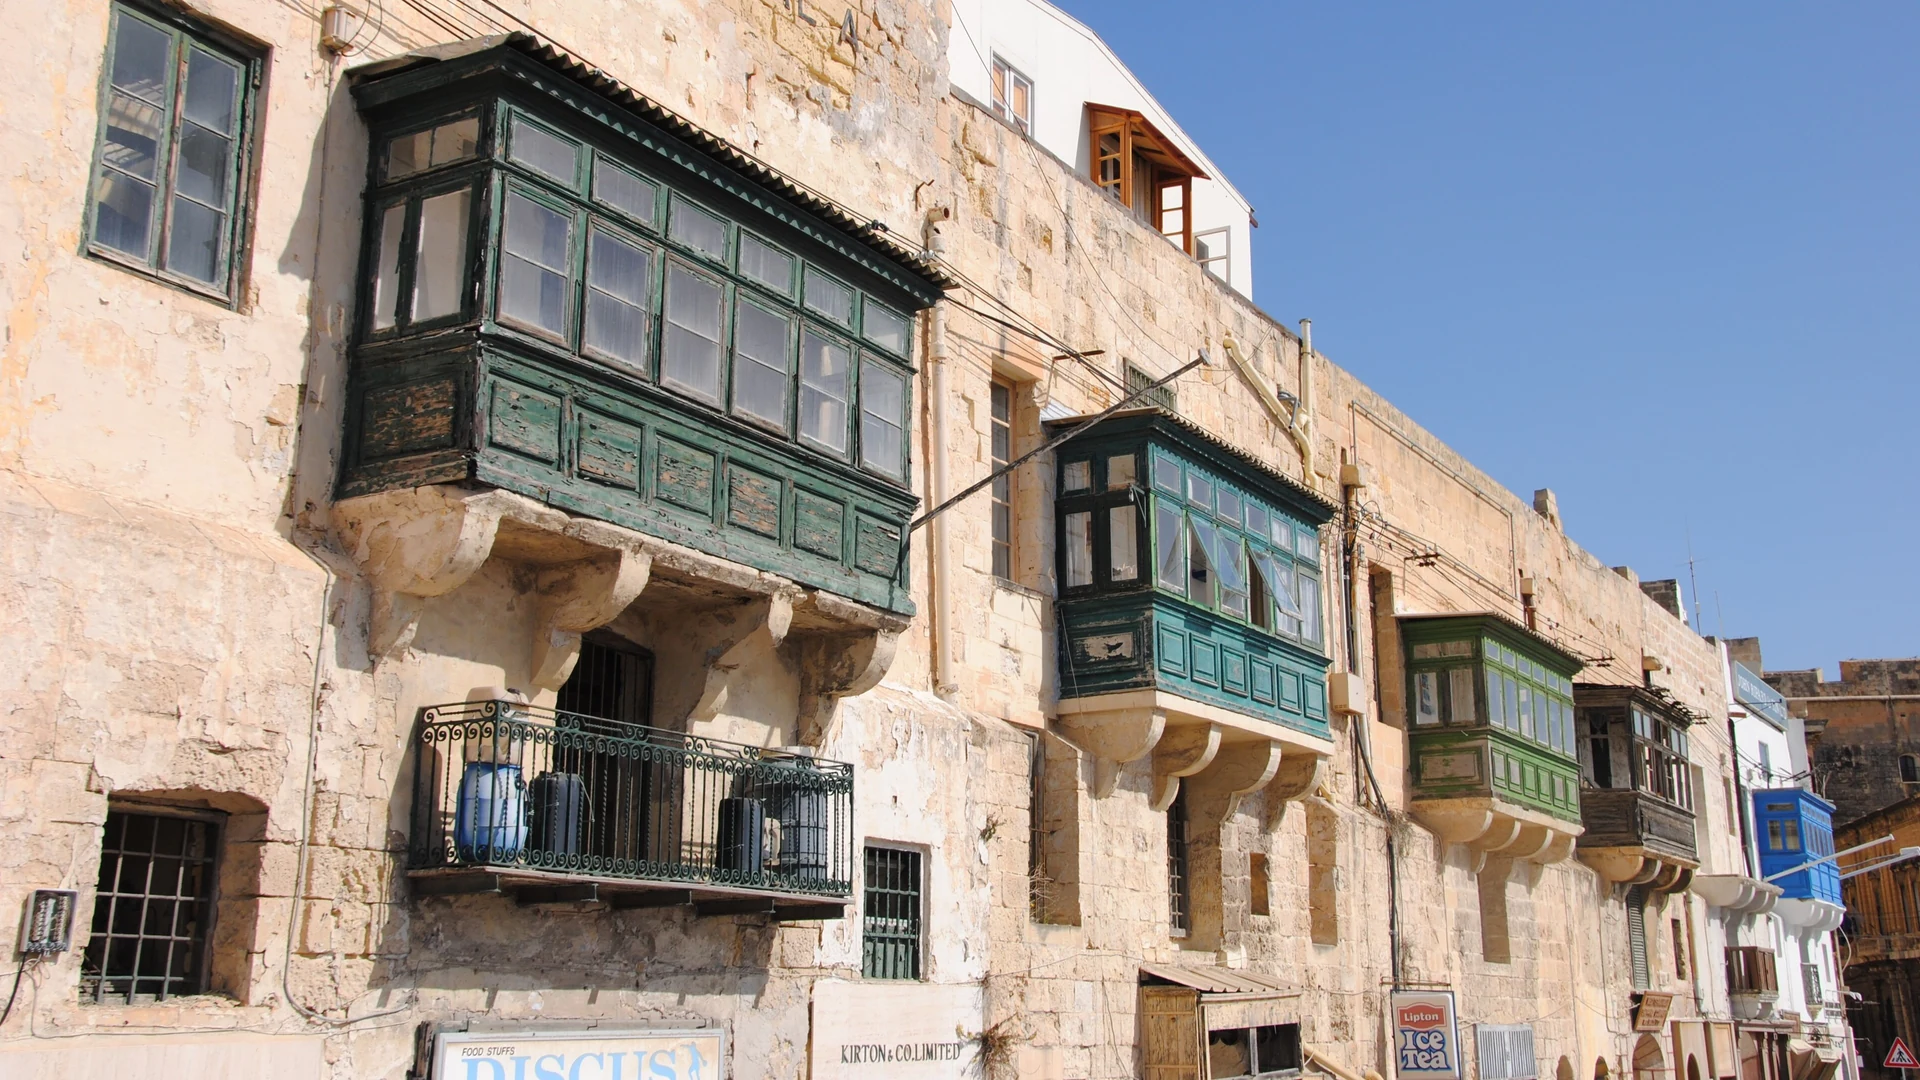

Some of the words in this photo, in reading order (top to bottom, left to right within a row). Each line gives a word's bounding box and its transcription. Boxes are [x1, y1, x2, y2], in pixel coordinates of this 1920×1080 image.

[1404, 1012, 1439, 1023] Lipton
[1402, 1030, 1445, 1051] Ice
[461, 1047, 484, 1057] FOOD
[486, 1046, 515, 1056] STUFFS
[841, 1044, 886, 1063] KIRTON
[1402, 1050, 1450, 1070] Tea
